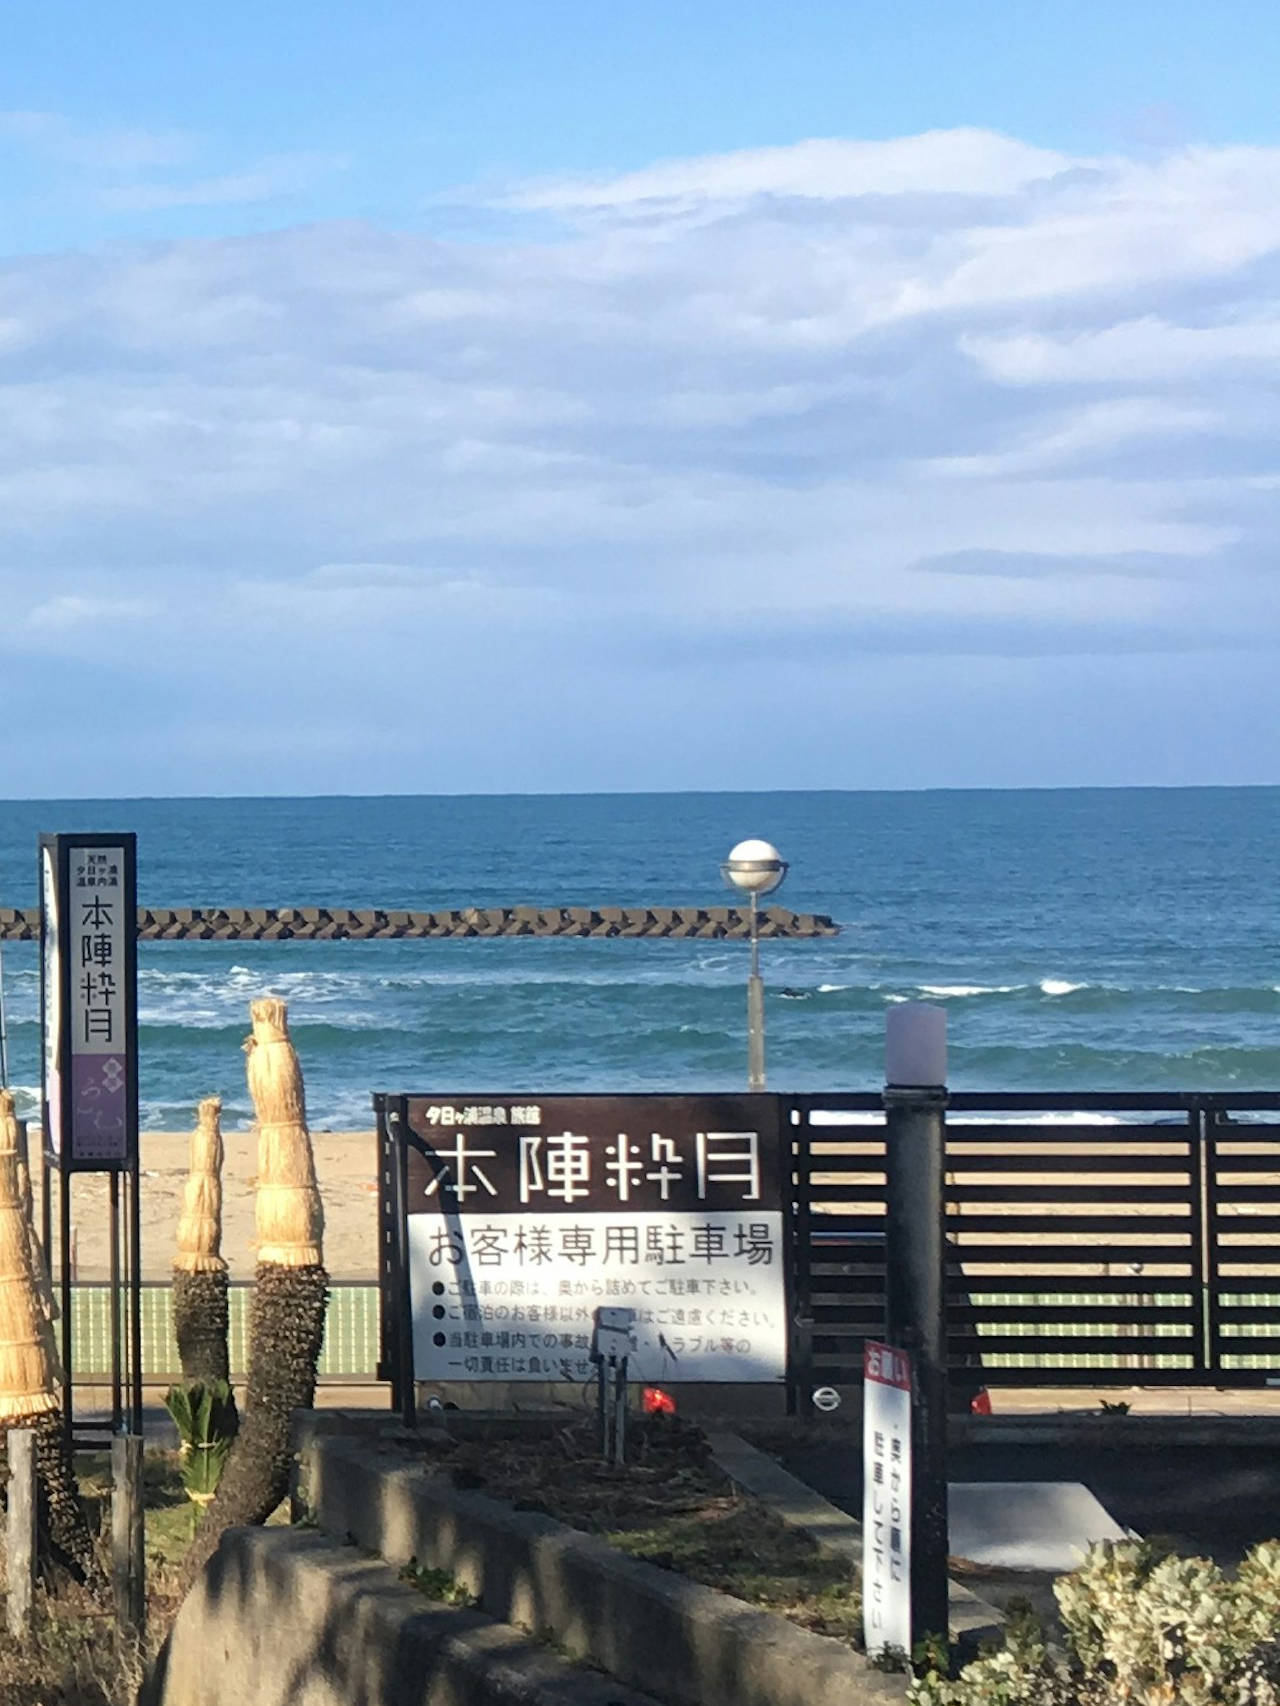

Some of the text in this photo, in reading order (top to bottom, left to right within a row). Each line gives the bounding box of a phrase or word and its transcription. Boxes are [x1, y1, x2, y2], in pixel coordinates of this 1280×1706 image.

[80, 894, 116, 1043] 本陣粋月
[423, 1131, 761, 1204] 本陣粋月
[428, 1222, 774, 1267] お客様専用駐車場
[448, 1304, 776, 1328] ご宿泊のお客様以外車はご遠慮ください。
